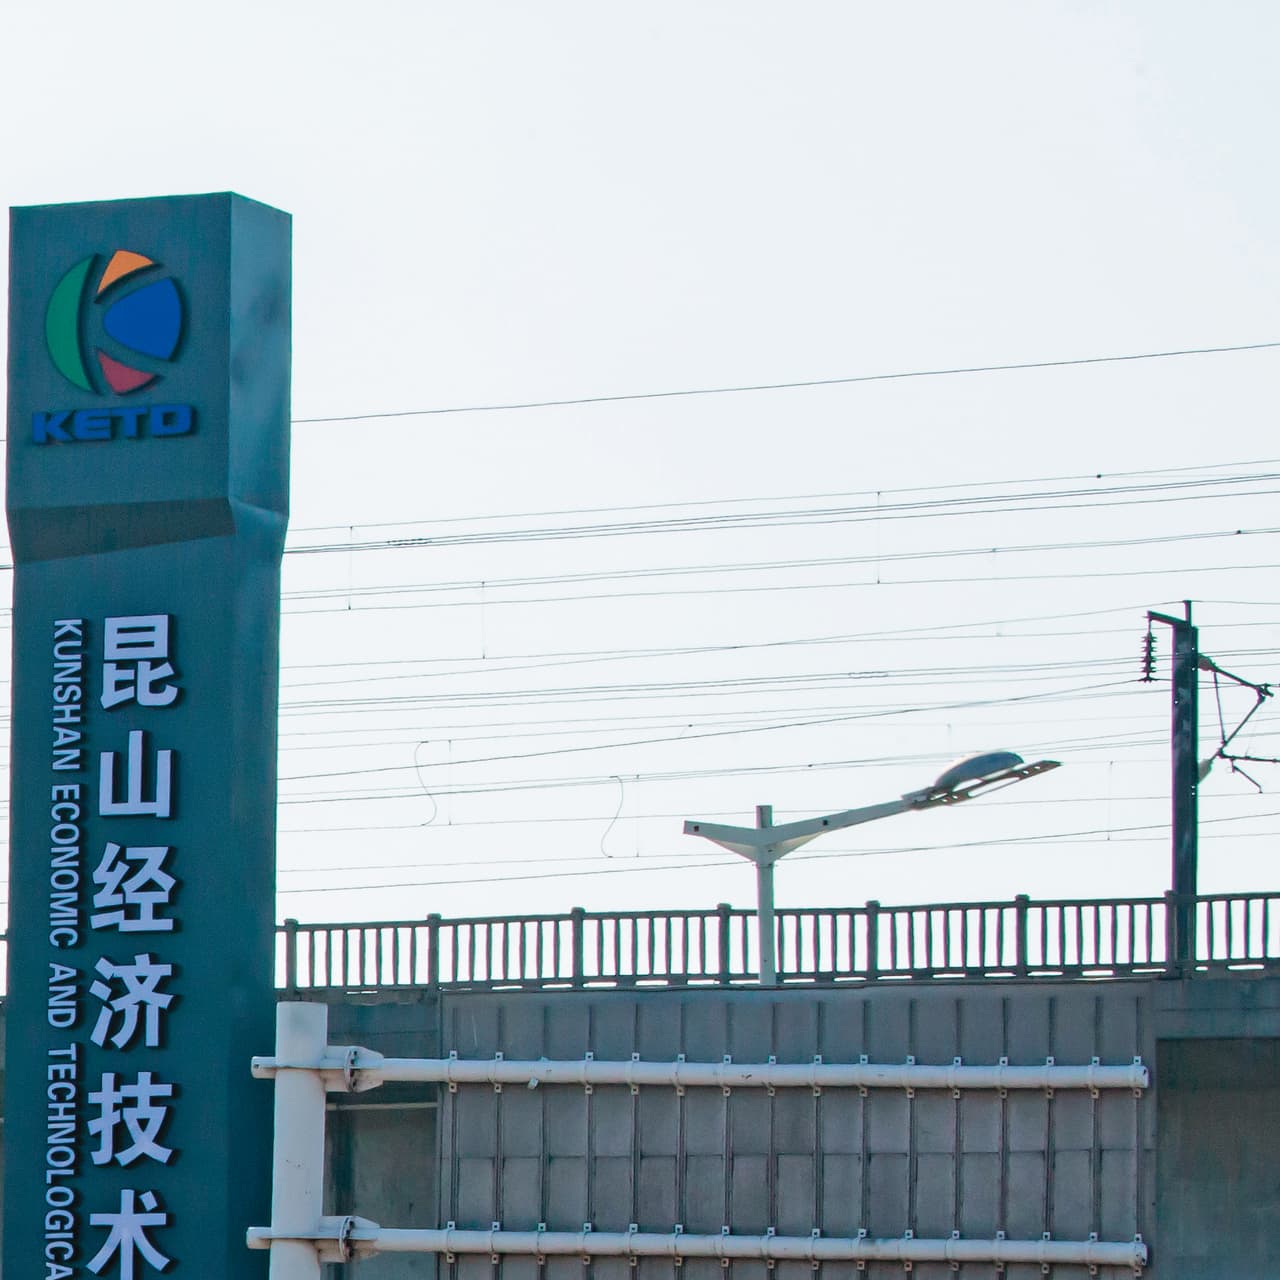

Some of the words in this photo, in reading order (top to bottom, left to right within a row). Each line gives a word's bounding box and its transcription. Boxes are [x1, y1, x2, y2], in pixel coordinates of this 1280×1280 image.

[52, 619, 82, 771] KUNSHAN
[49, 784, 80, 948] ECONOMIC
[47, 962, 77, 1028] AND
